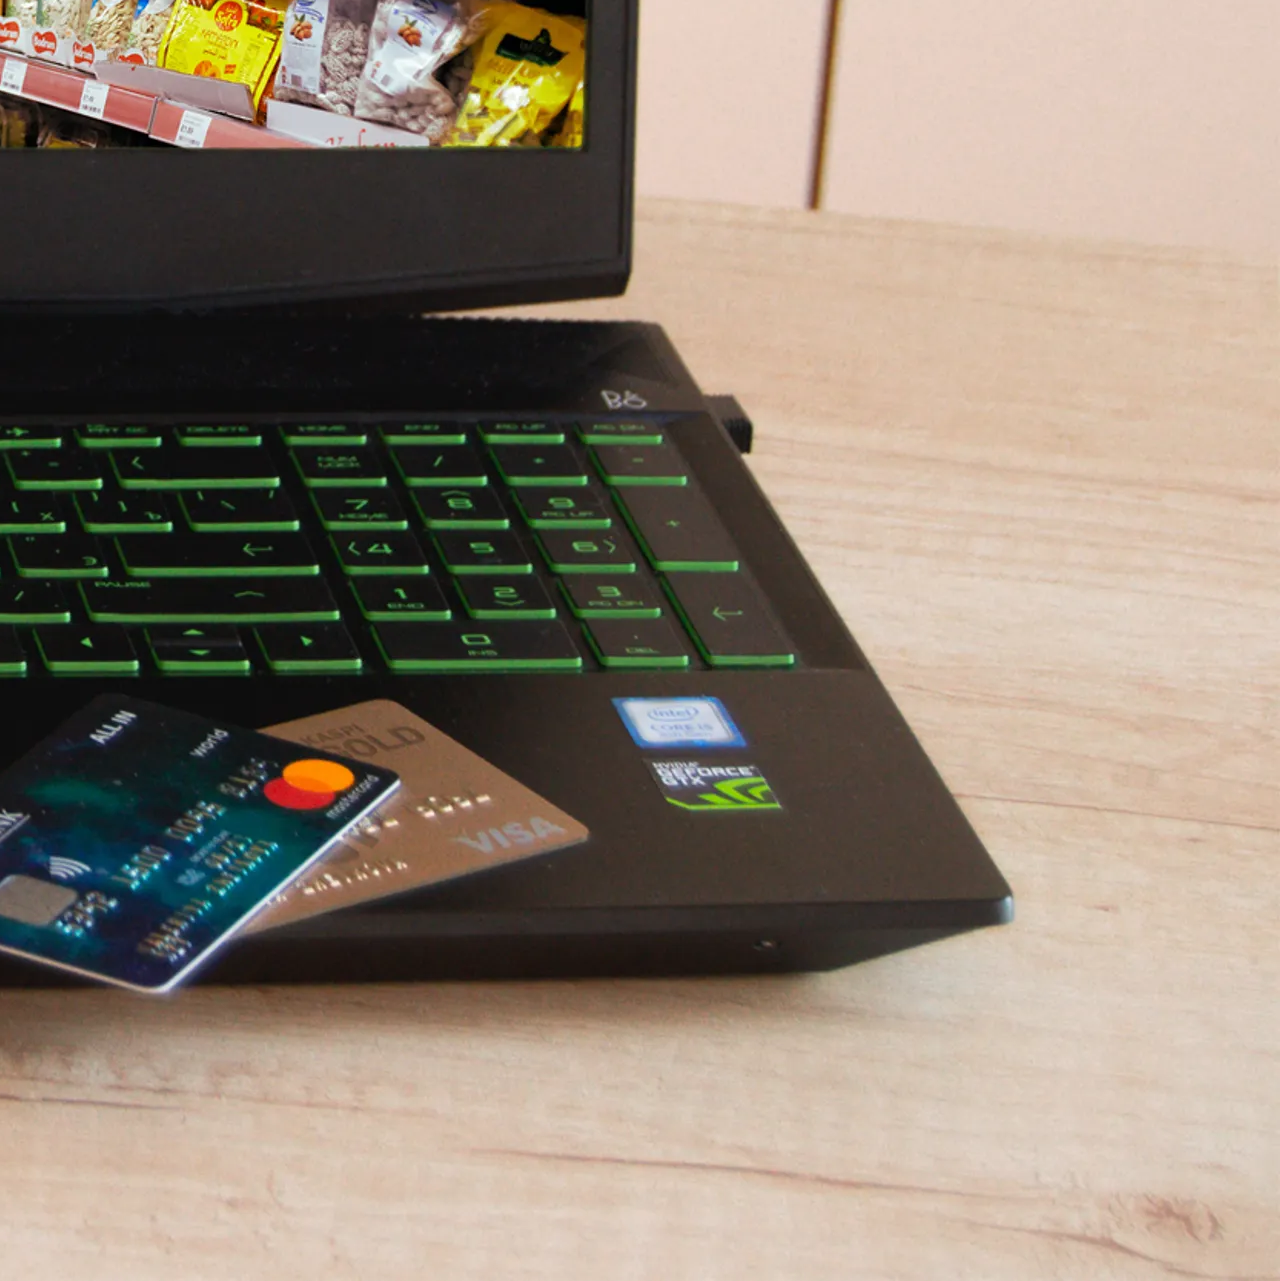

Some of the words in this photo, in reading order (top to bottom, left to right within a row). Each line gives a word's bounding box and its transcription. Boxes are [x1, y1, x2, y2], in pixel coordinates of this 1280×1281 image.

[346, 499, 369, 510] 7
[447, 498, 473, 509] 8
[549, 497, 575, 508] 9
[367, 543, 393, 554] 4
[469, 542, 495, 554] 5
[572, 541, 598, 552] 6
[394, 588, 407, 600] 1
[494, 587, 517, 598] 2
[598, 586, 621, 597] 3
[461, 634, 492, 645] 0
[652, 707, 693, 718] intel
[90, 724, 123, 745] ALL
[111, 710, 137, 725] IN
[650, 723, 693, 732] CORE
[190, 728, 230, 759] world
[657, 766, 753, 777] GEFORCE
[662, 776, 706, 786] GTX
[326, 773, 381, 820] mastercard
[453, 815, 567, 854] VISA
